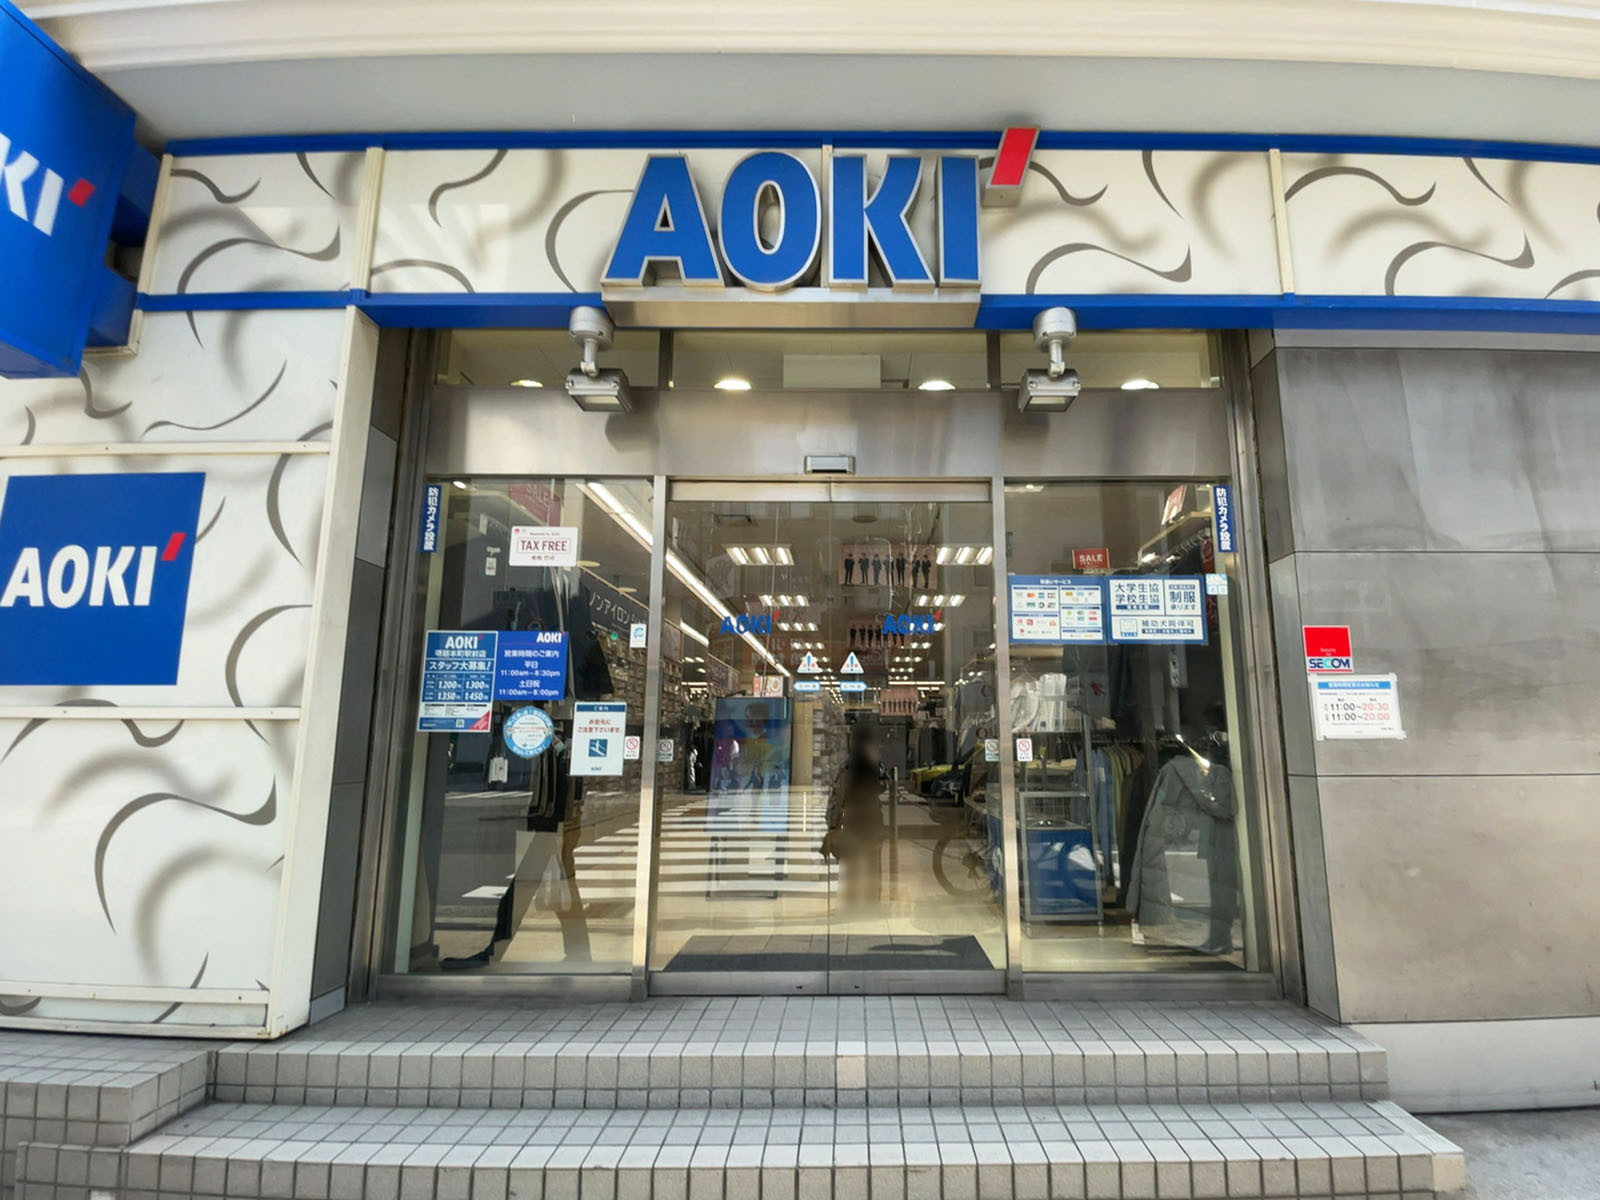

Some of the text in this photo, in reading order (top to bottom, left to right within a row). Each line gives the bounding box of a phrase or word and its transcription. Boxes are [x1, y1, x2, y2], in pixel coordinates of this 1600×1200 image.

[600, 151, 982, 294] AOKI
[423, 487, 439, 552] 防犯カメラ設置
[1215, 487, 1232, 551] 防犯カメラ設置
[521, 540, 568, 552] TAX FREE
[1079, 553, 1103, 563] SALE
[0, 545, 158, 609] AOKI
[1115, 583, 1160, 593] 大学生協
[1115, 594, 1160, 604] 学校生協
[1169, 591, 1196, 603] 制服
[720, 613, 773, 635] AOKI
[883, 613, 934, 635] AOKI
[445, 635, 479, 649] AOKI
[536, 632, 562, 643] AOKI
[524, 660, 539, 669] 平日
[1308, 657, 1351, 669] SECOM
[519, 679, 541, 688] 土日祝
